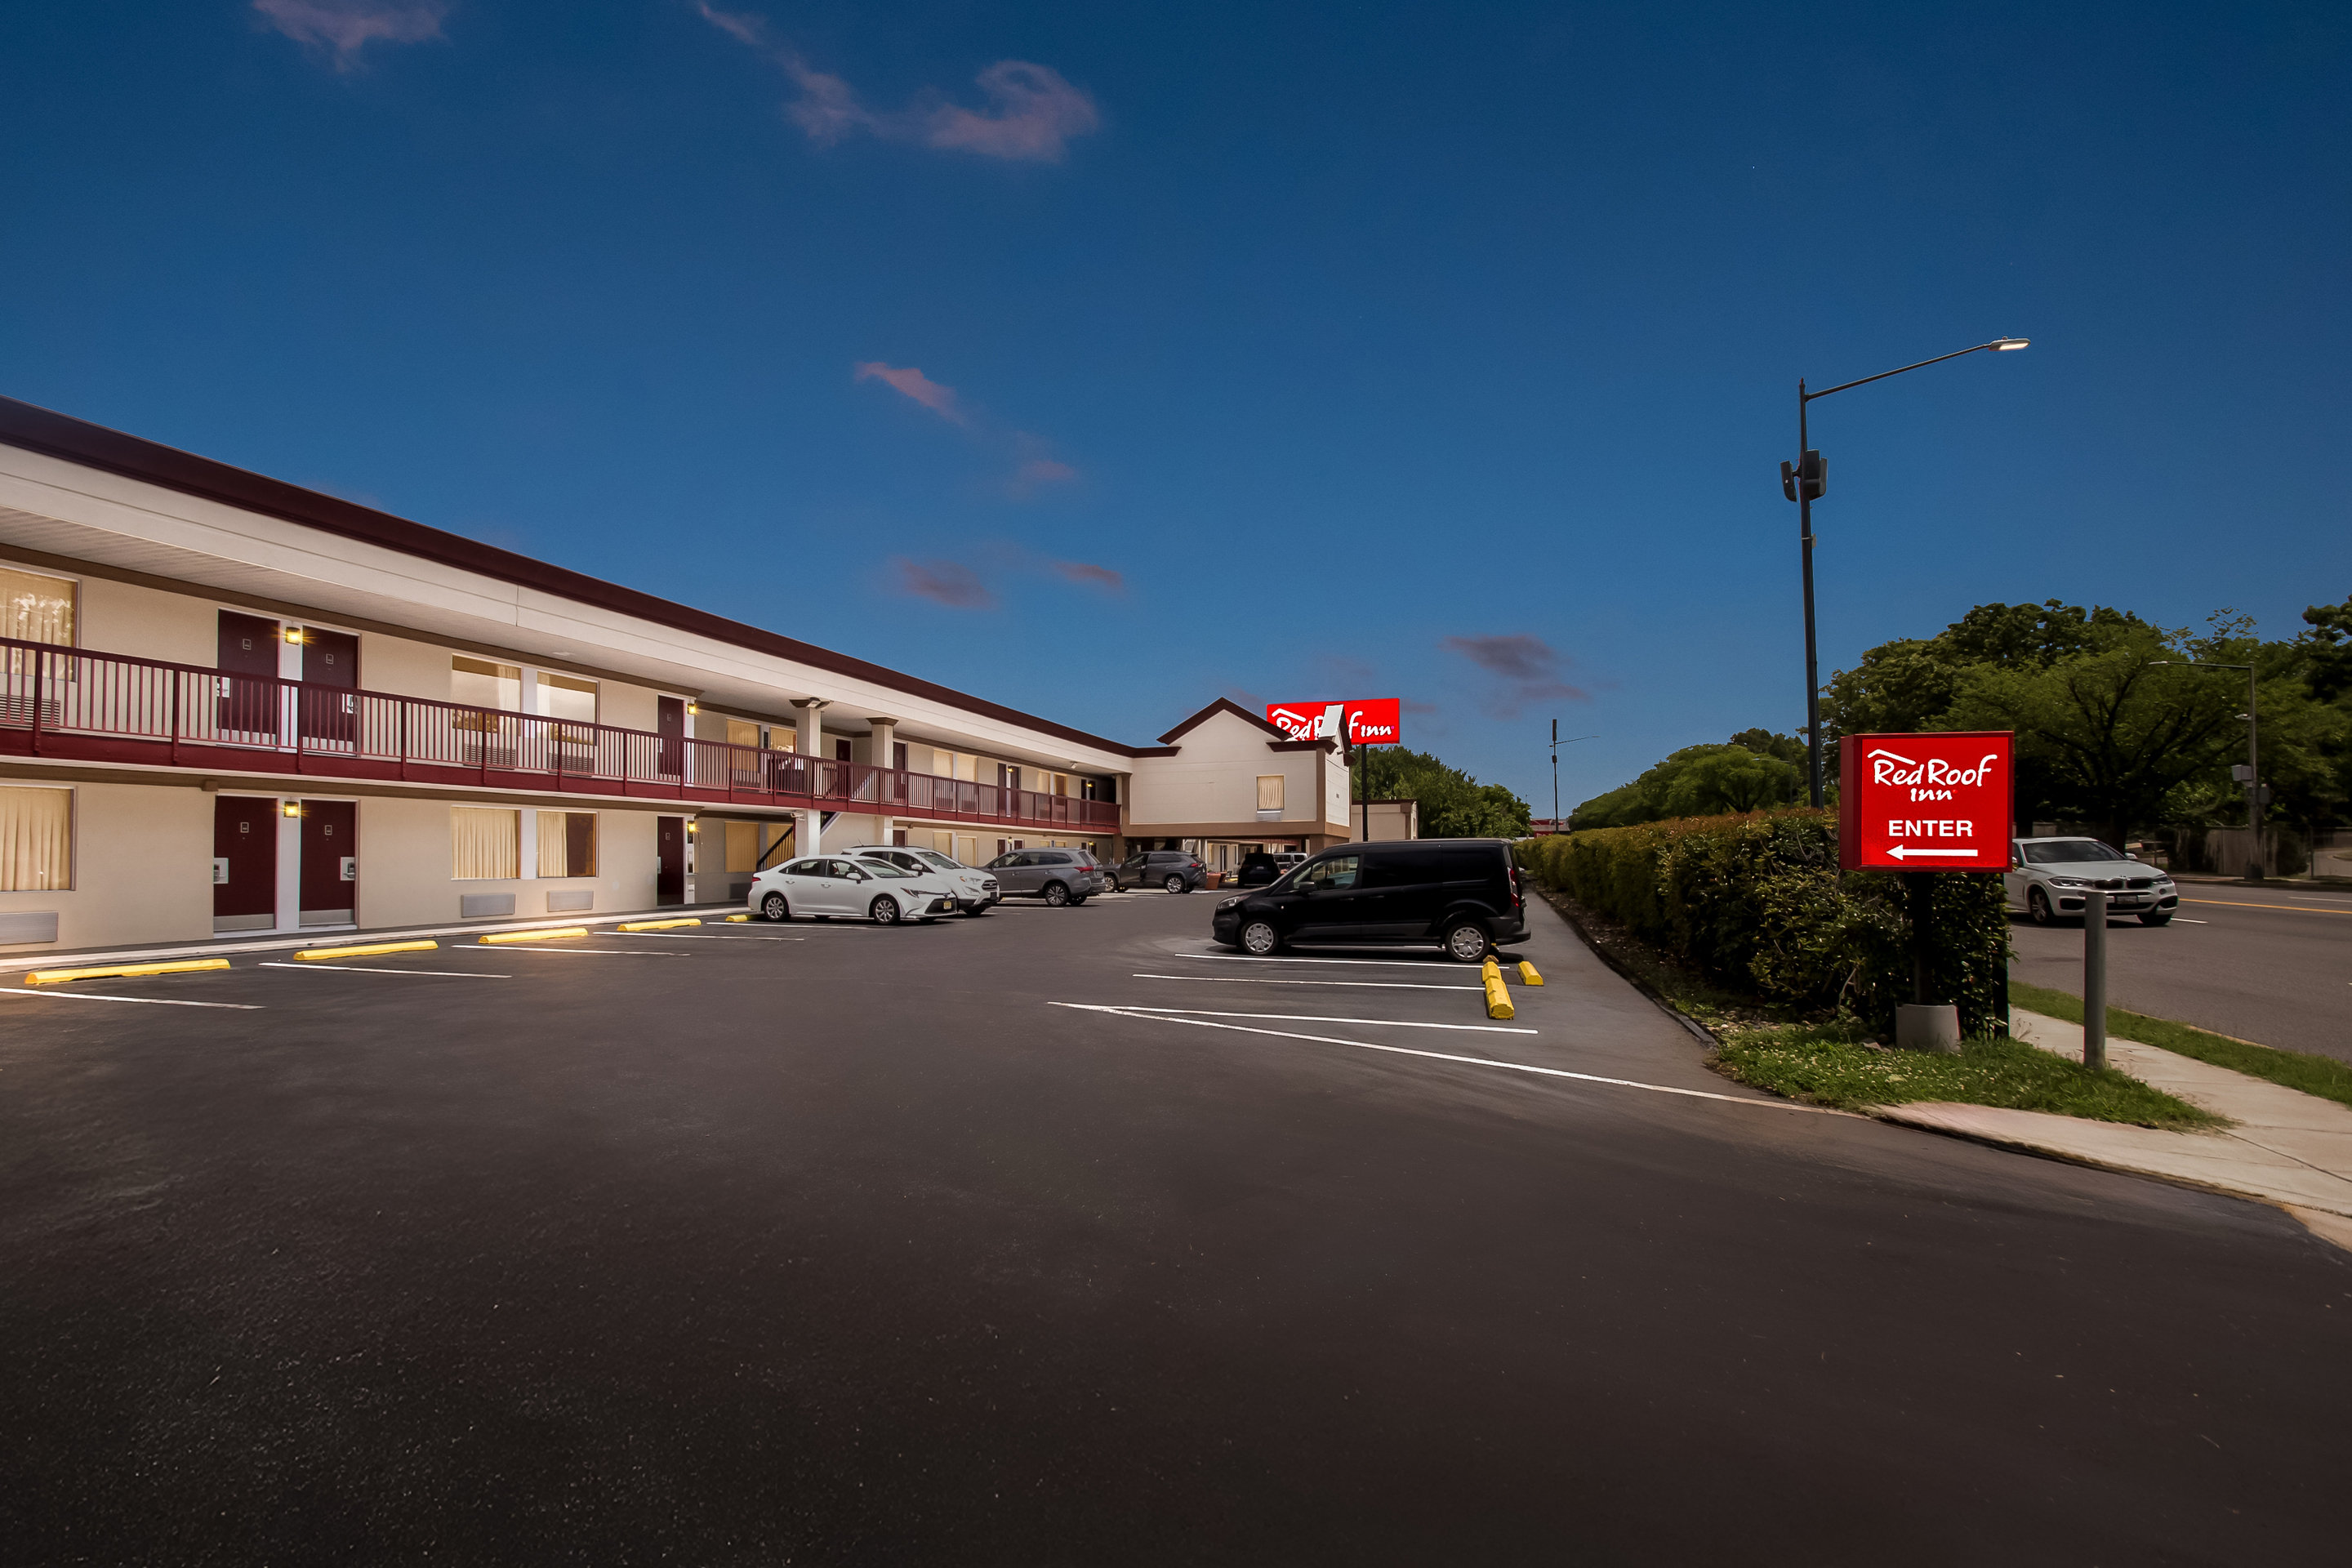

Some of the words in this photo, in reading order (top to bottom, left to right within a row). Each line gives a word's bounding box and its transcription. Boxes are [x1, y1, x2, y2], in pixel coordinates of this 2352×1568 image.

[1314, 711, 1363, 739] Rf
[1874, 759, 1924, 786] Red
[1928, 755, 1998, 786] Roof
[1889, 820, 1972, 837] ENTER
